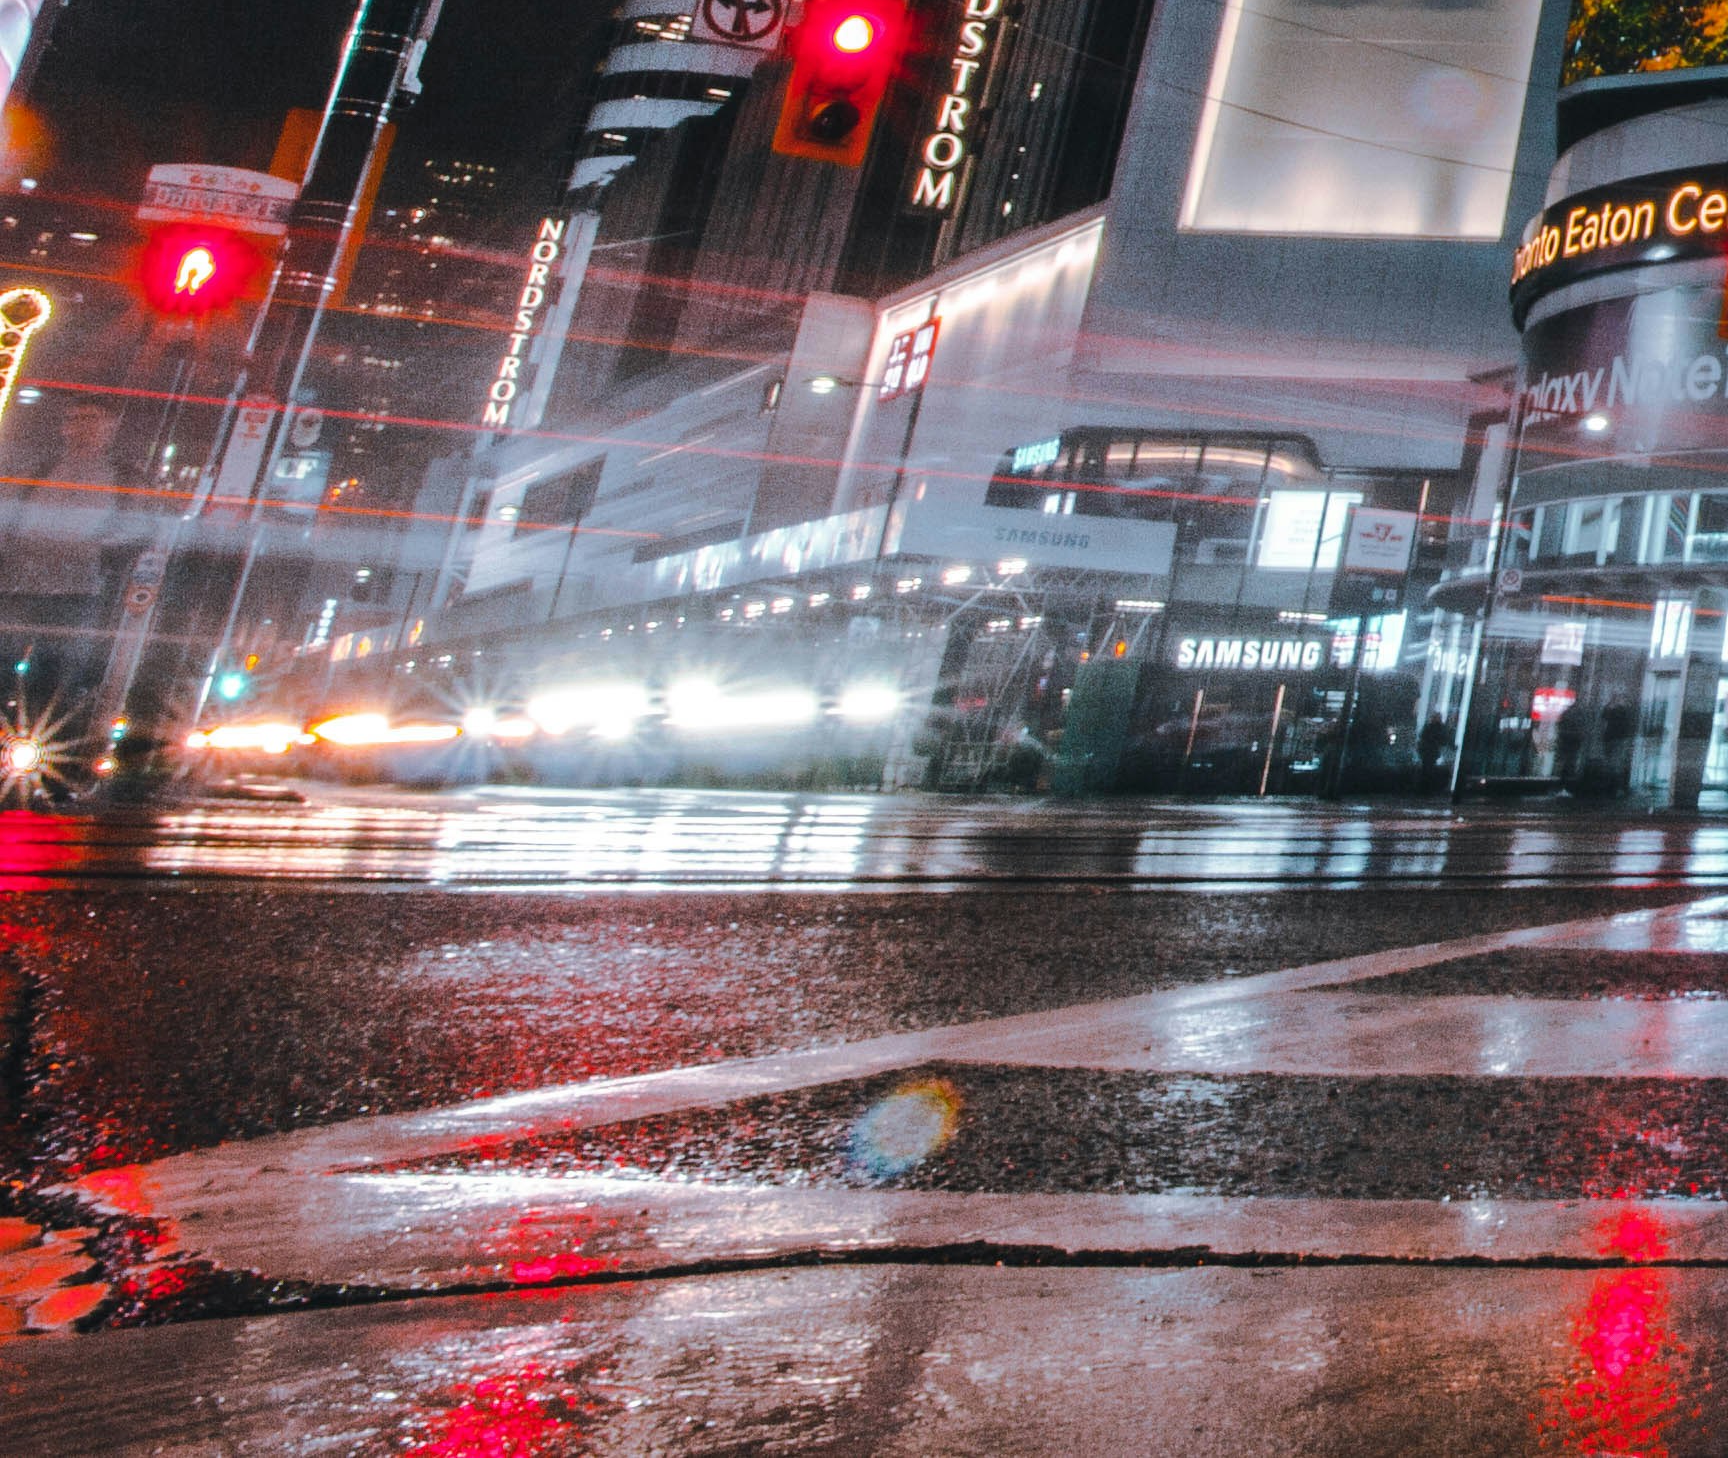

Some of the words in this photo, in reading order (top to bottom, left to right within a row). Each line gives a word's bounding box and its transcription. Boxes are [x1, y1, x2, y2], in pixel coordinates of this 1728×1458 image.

[1561, 202, 1656, 259] Eaton
[482, 216, 566, 429] NORDSTROM
[1526, 362, 1606, 404] alaxy
[993, 525, 1090, 550] SAMSUNG
[1177, 639, 1322, 670] SAMSUNG
